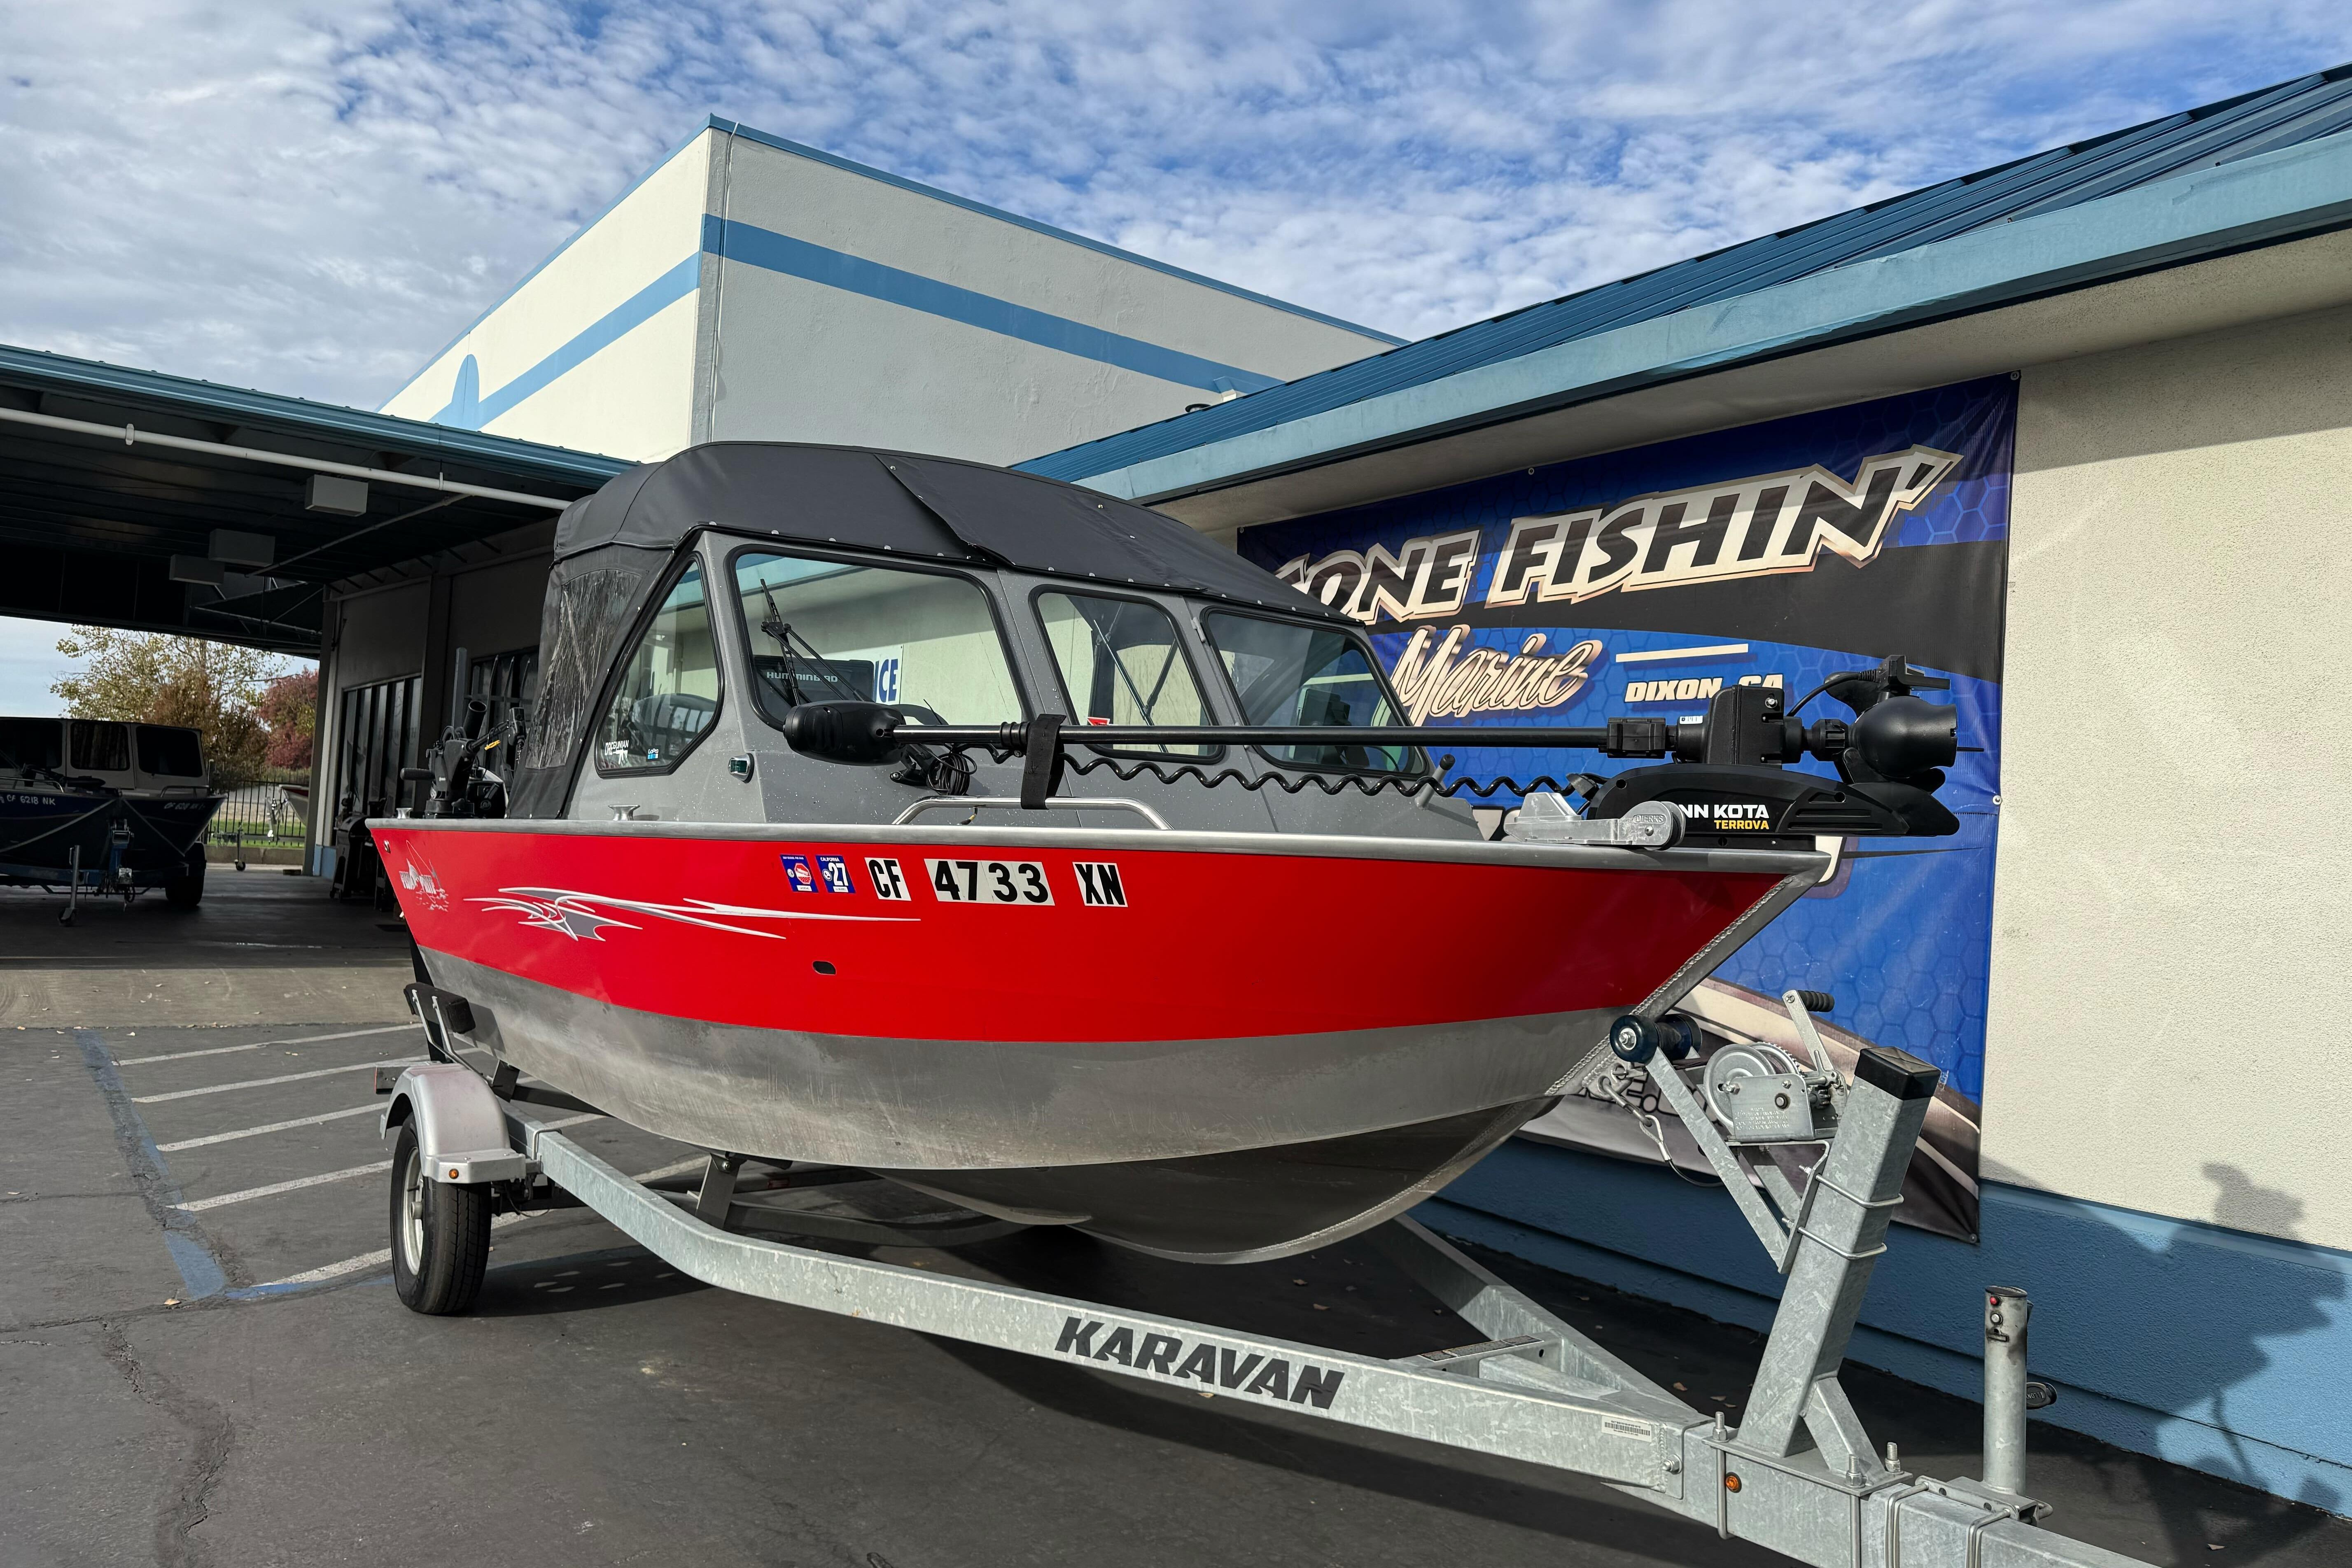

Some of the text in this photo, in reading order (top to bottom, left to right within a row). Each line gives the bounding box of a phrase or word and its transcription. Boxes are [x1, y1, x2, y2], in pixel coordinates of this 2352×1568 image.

[1485, 444, 1963, 606] FISHIN'
[767, 672, 838, 682] HUMMINBRD
[1390, 625, 1603, 727] Marine
[20, 796, 39, 805] 6218
[42, 797, 56, 805] NK
[1679, 805, 1769, 819] NN KOTA
[1714, 820, 1769, 830] TERROVA
[828, 863, 849, 886] 27
[869, 859, 1125, 905] CF 4733 XN
[1055, 1316, 1345, 1410] KARAVAN
